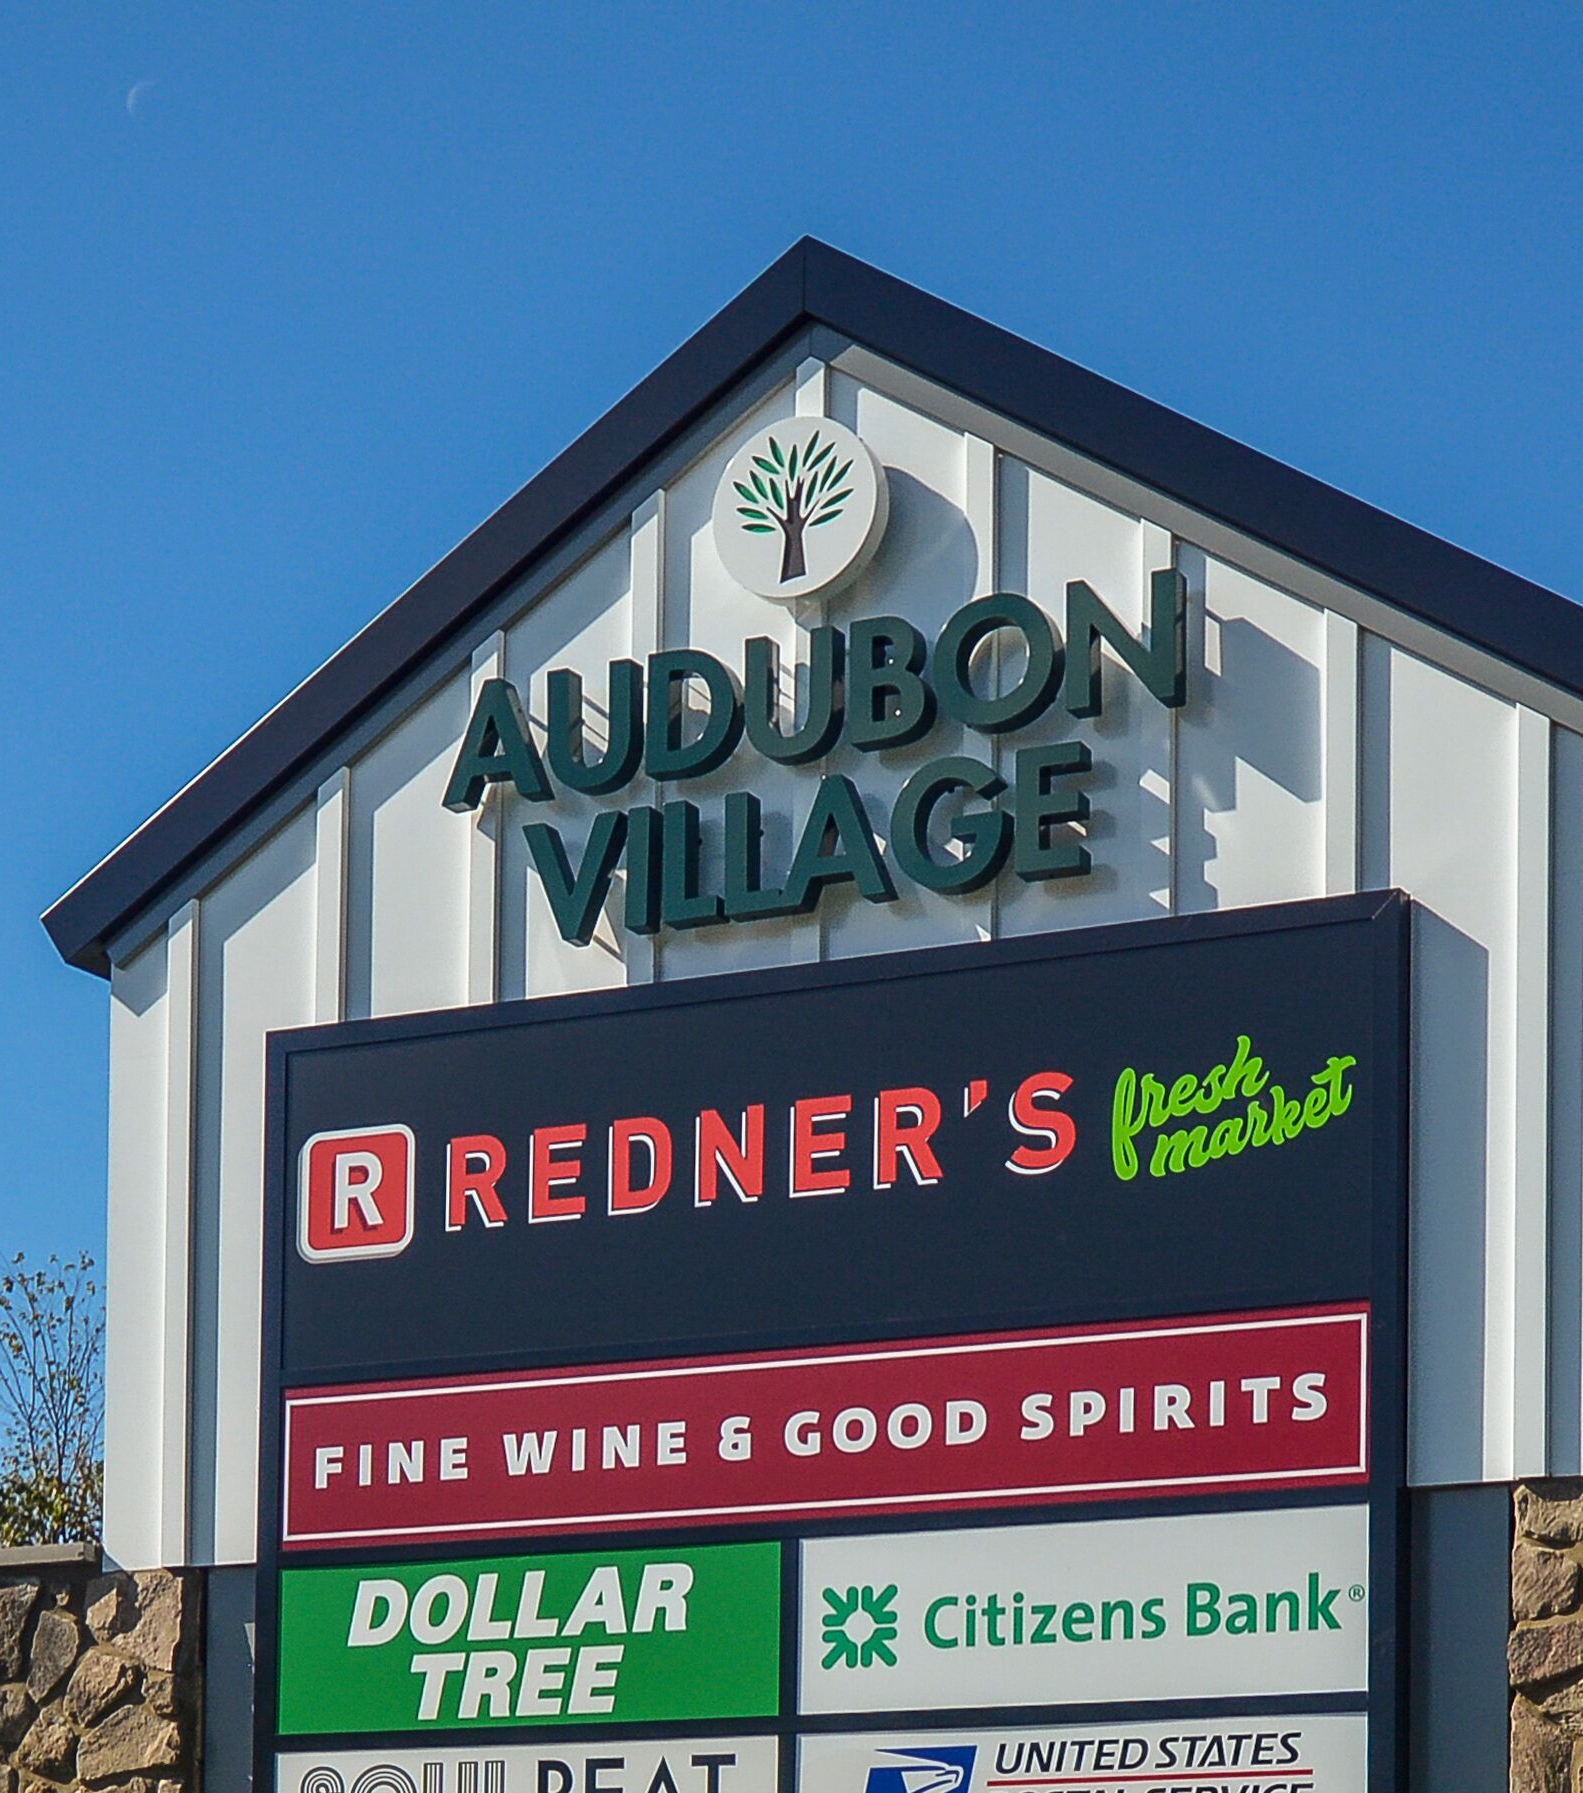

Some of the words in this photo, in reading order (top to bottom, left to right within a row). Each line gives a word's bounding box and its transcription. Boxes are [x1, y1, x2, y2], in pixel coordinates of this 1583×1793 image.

[441, 568, 1187, 814] AUDUBON
[523, 741, 1093, 947] VILLAGE
[445, 1071, 1077, 1233] REDNER'S
[1111, 1036, 1270, 1181] fresh
[1148, 1055, 1356, 1177] market
[331, 1150, 384, 1235] R
[314, 1434, 471, 1490] FINE
[502, 1418, 689, 1477] WINE
[718, 1416, 752, 1462] &
[783, 1399, 988, 1457] GOOD
[1019, 1372, 1328, 1442] SPIRITS
[345, 1562, 695, 1648] DOLLAR
[924, 1590, 1168, 1651] Citizens
[410, 1645, 624, 1720] TREE
[994, 1740, 1149, 1777] UNITED
[1154, 1732, 1301, 1770] STATES
